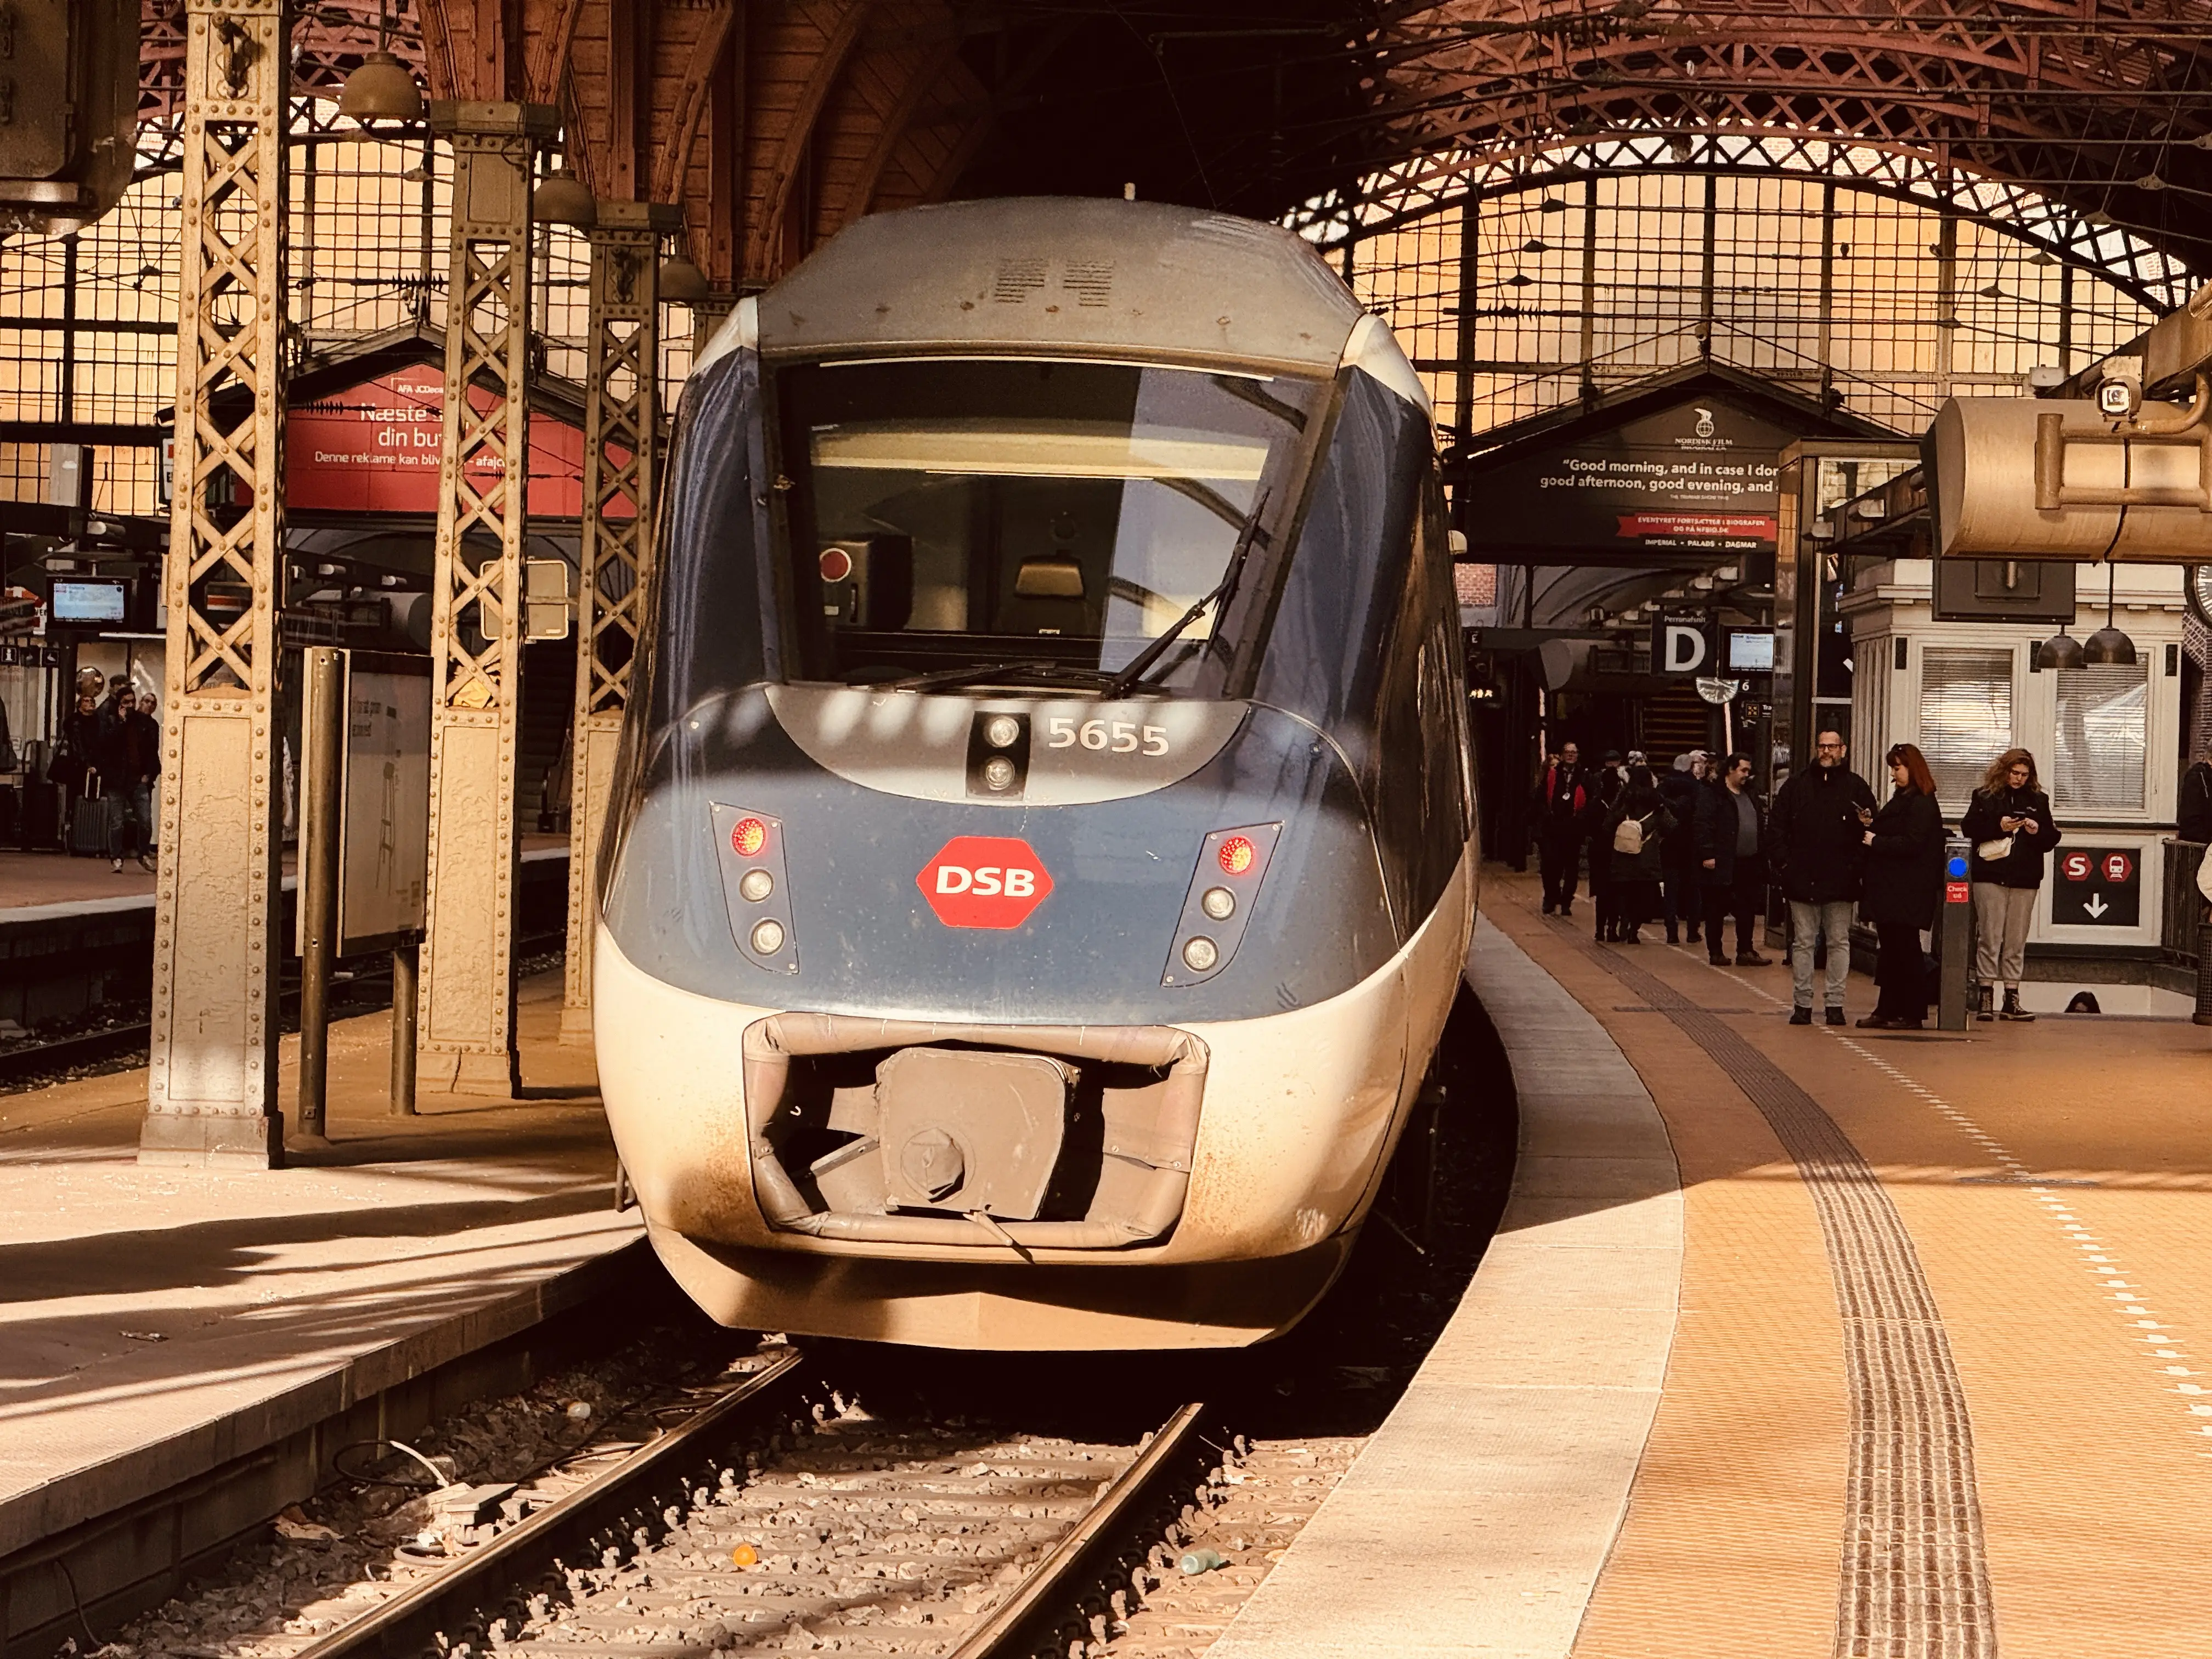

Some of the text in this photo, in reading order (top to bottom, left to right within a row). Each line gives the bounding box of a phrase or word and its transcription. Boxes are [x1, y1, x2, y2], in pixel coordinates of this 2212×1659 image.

[397, 385, 413, 393] AFA
[360, 403, 427, 422] Næste
[379, 427, 407, 447] din
[315, 452, 349, 463] Denne
[352, 453, 396, 464] rekame
[399, 453, 417, 465] kan
[421, 454, 441, 465] bliv
[1609, 461, 1668, 476] morning,
[1671, 462, 1696, 475] and
[1700, 462, 1712, 475] in
[1715, 466, 1744, 476] case
[1541, 475, 1574, 488] good
[1578, 476, 1646, 490] afternoon,
[1649, 477, 1684, 492] good
[1688, 479, 1744, 494] evening,
[1747, 480, 1773, 492] and
[1665, 625, 1706, 672] D
[1742, 681, 1750, 691] 6
[1048, 717, 1170, 757] 5655
[2068, 857, 2086, 876] S
[935, 865, 1035, 898] DSB
